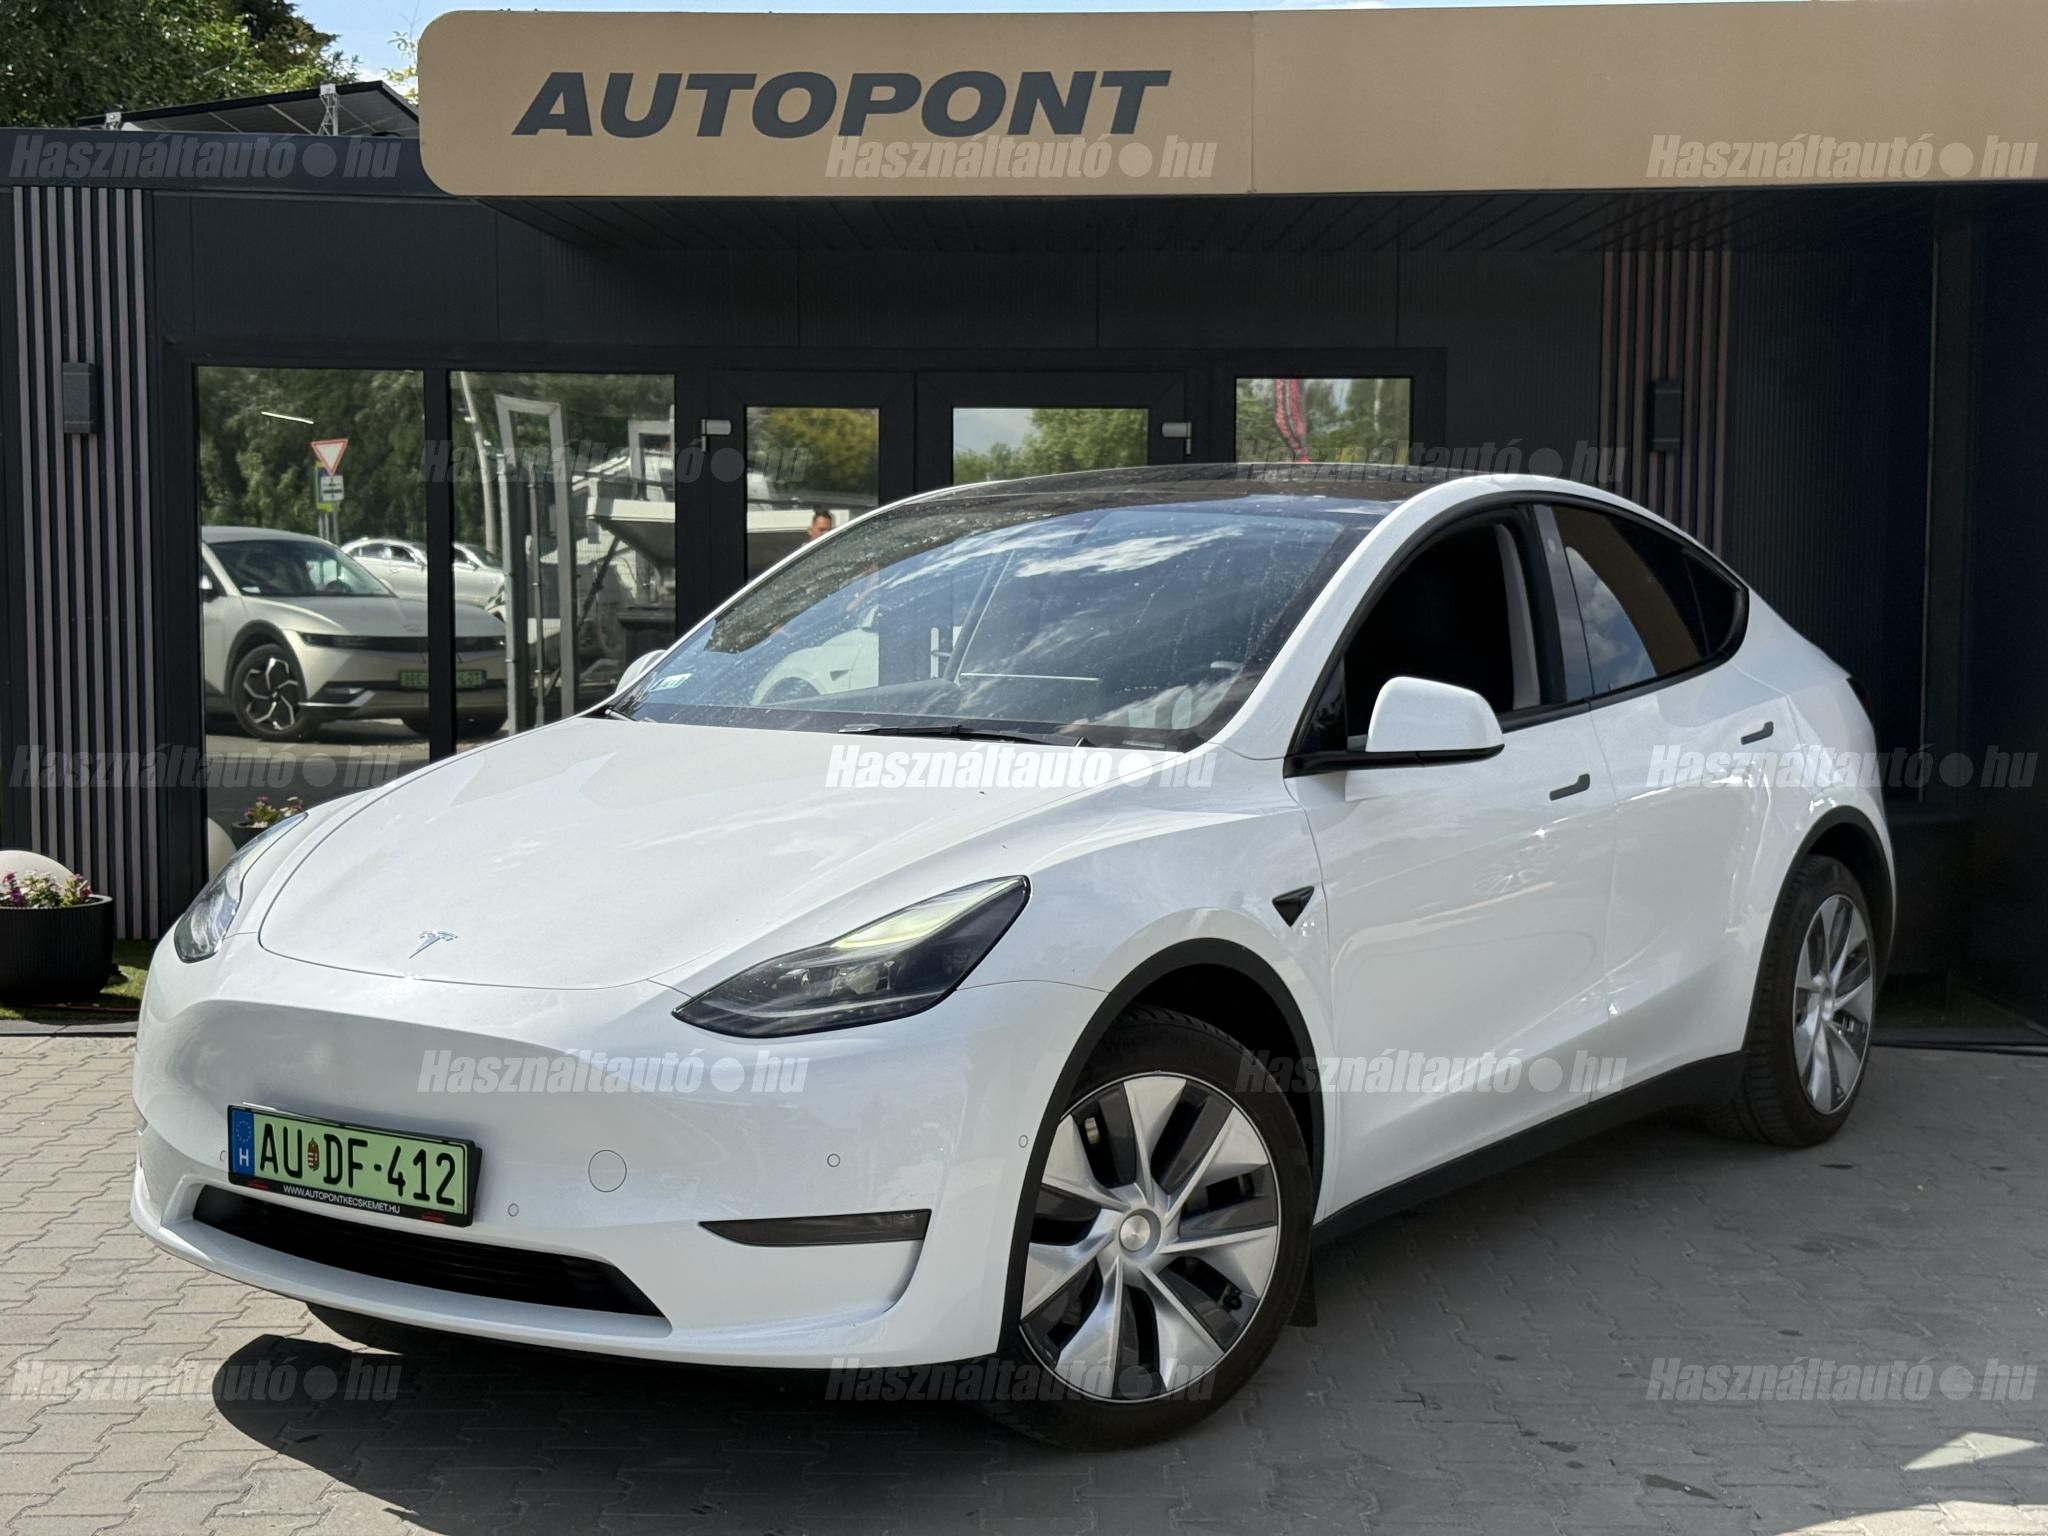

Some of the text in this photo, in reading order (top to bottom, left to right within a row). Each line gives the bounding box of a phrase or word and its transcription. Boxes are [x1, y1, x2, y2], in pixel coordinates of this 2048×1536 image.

[512, 70, 1171, 138] AUTOPONT
[238, 1148, 250, 1168] H
[282, 1184, 401, 1214] WWW.AUTOPONTKECSKEMET.HU
